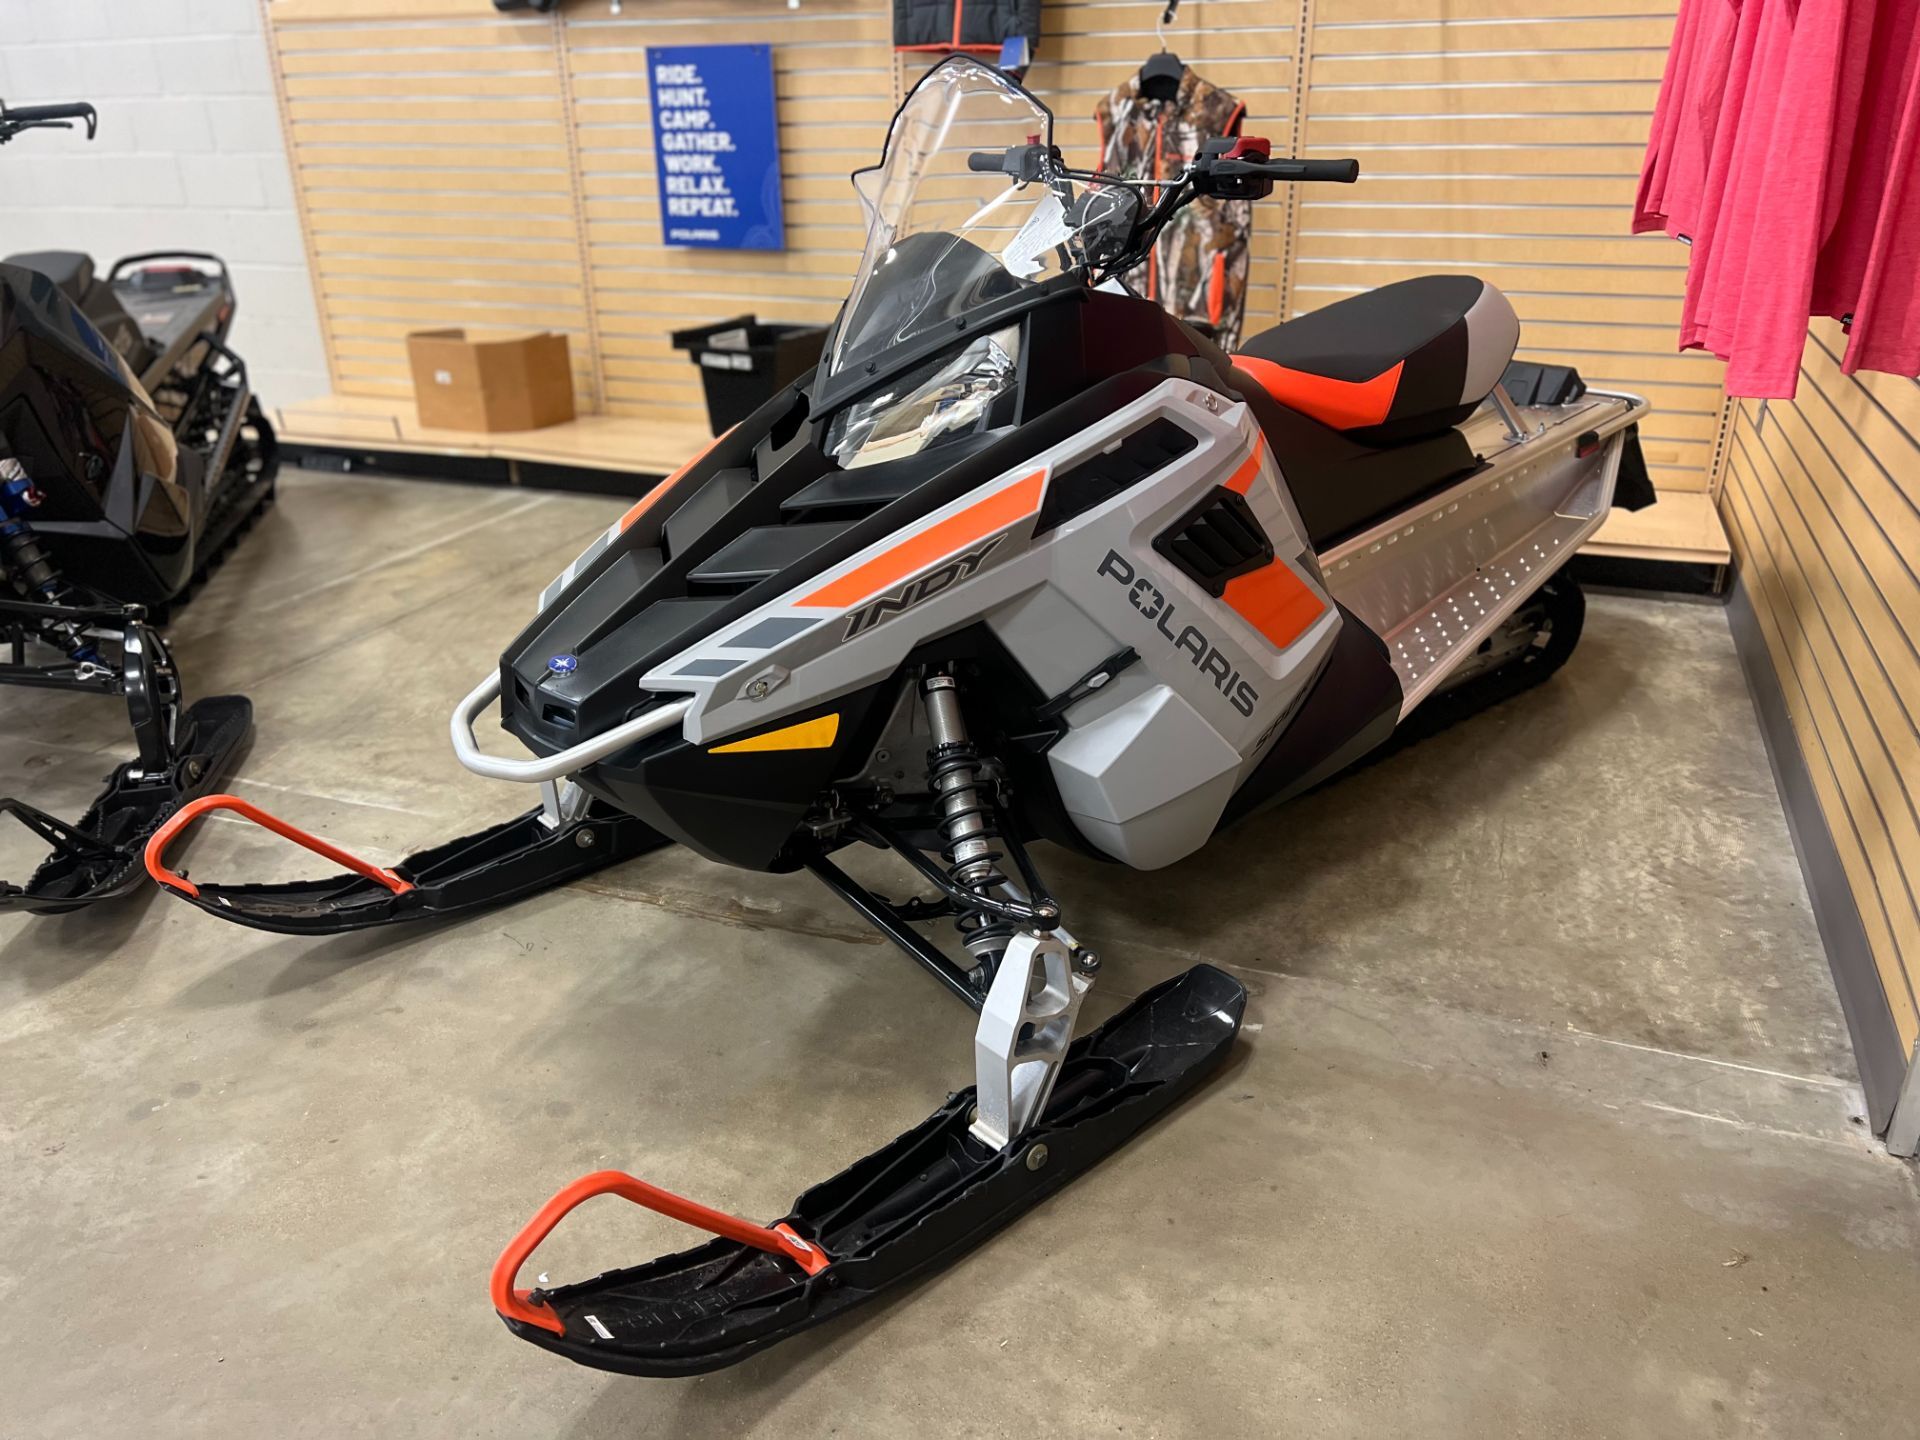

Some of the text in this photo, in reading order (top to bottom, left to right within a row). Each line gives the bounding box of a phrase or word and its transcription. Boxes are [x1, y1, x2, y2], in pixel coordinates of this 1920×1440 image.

[656, 64, 702, 85] RIDE.
[658, 87, 710, 107] HUNT.
[660, 110, 715, 130] CAMP.
[661, 132, 736, 152] GATHER.
[664, 154, 721, 173] WORK.
[666, 176, 730, 195] RELAX.
[668, 197, 738, 216] REPEAT.
[842, 533, 1008, 642] INDY
[1097, 549, 1259, 718] POLARIS
